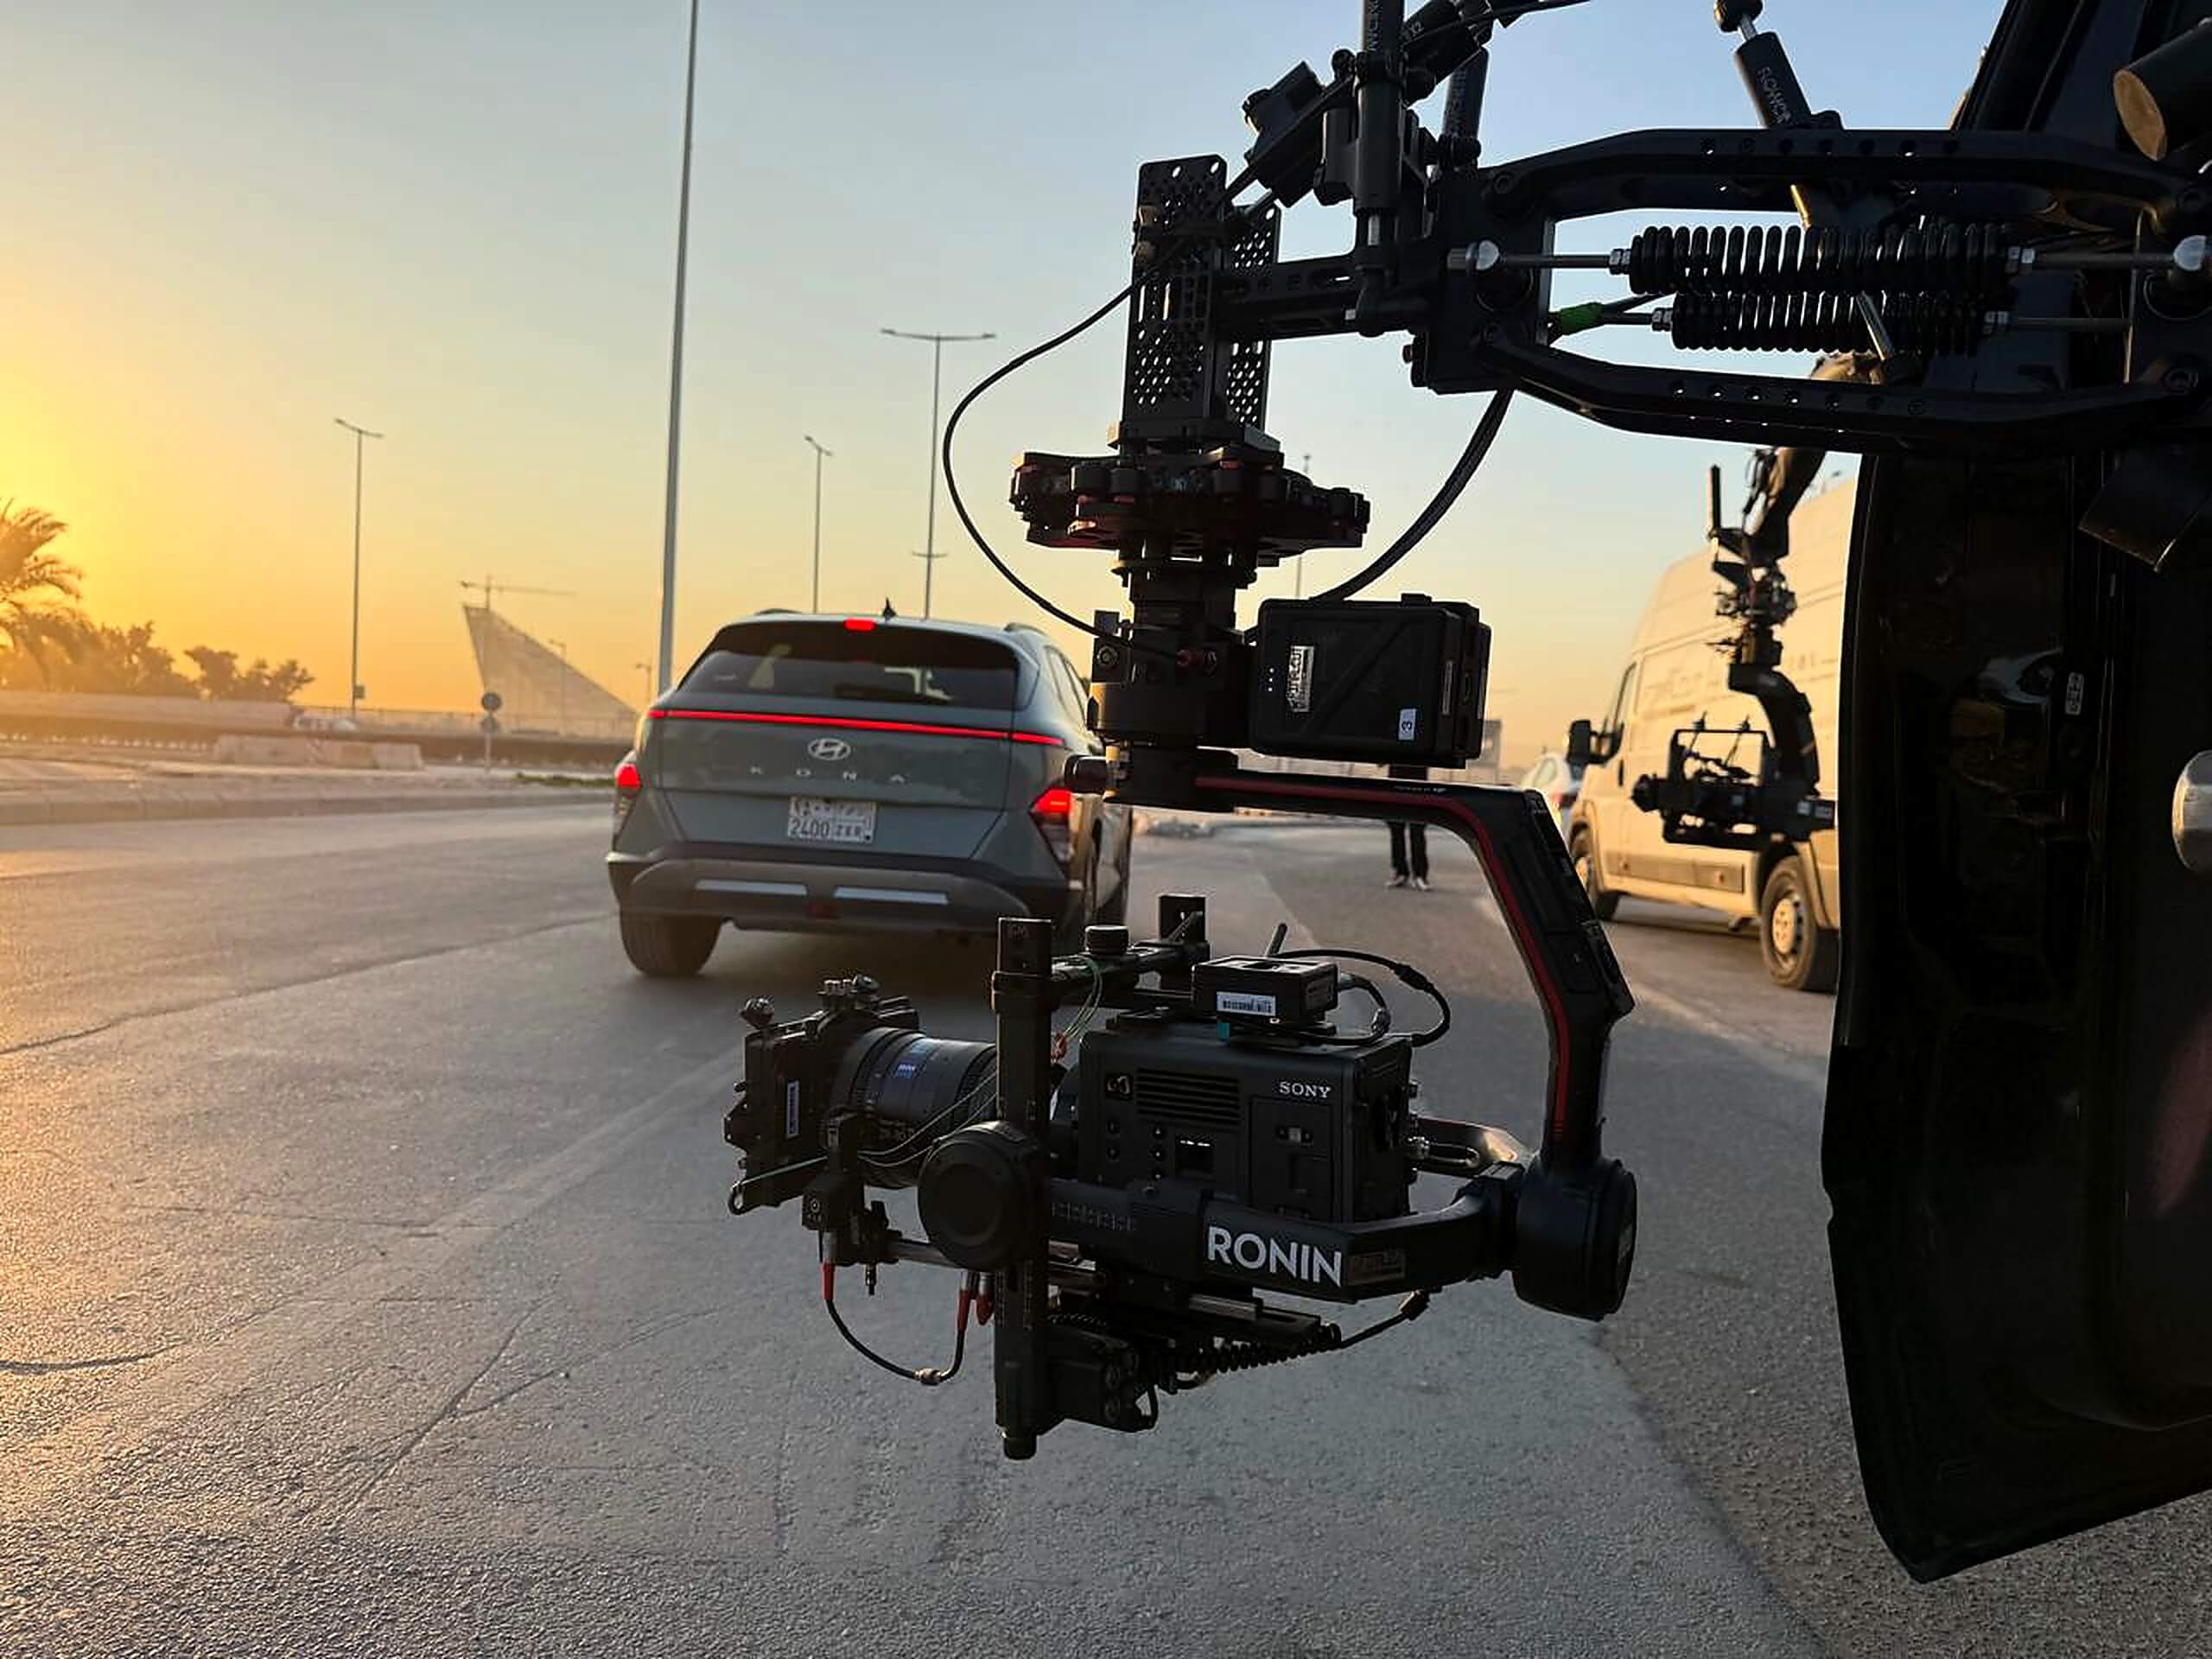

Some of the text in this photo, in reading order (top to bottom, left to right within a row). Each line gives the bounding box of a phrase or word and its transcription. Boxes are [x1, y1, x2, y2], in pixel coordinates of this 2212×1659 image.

[749, 765, 906, 784] KONA
[1279, 1081, 1331, 1098] SONY
[1208, 1226, 1343, 1287] RONIN
